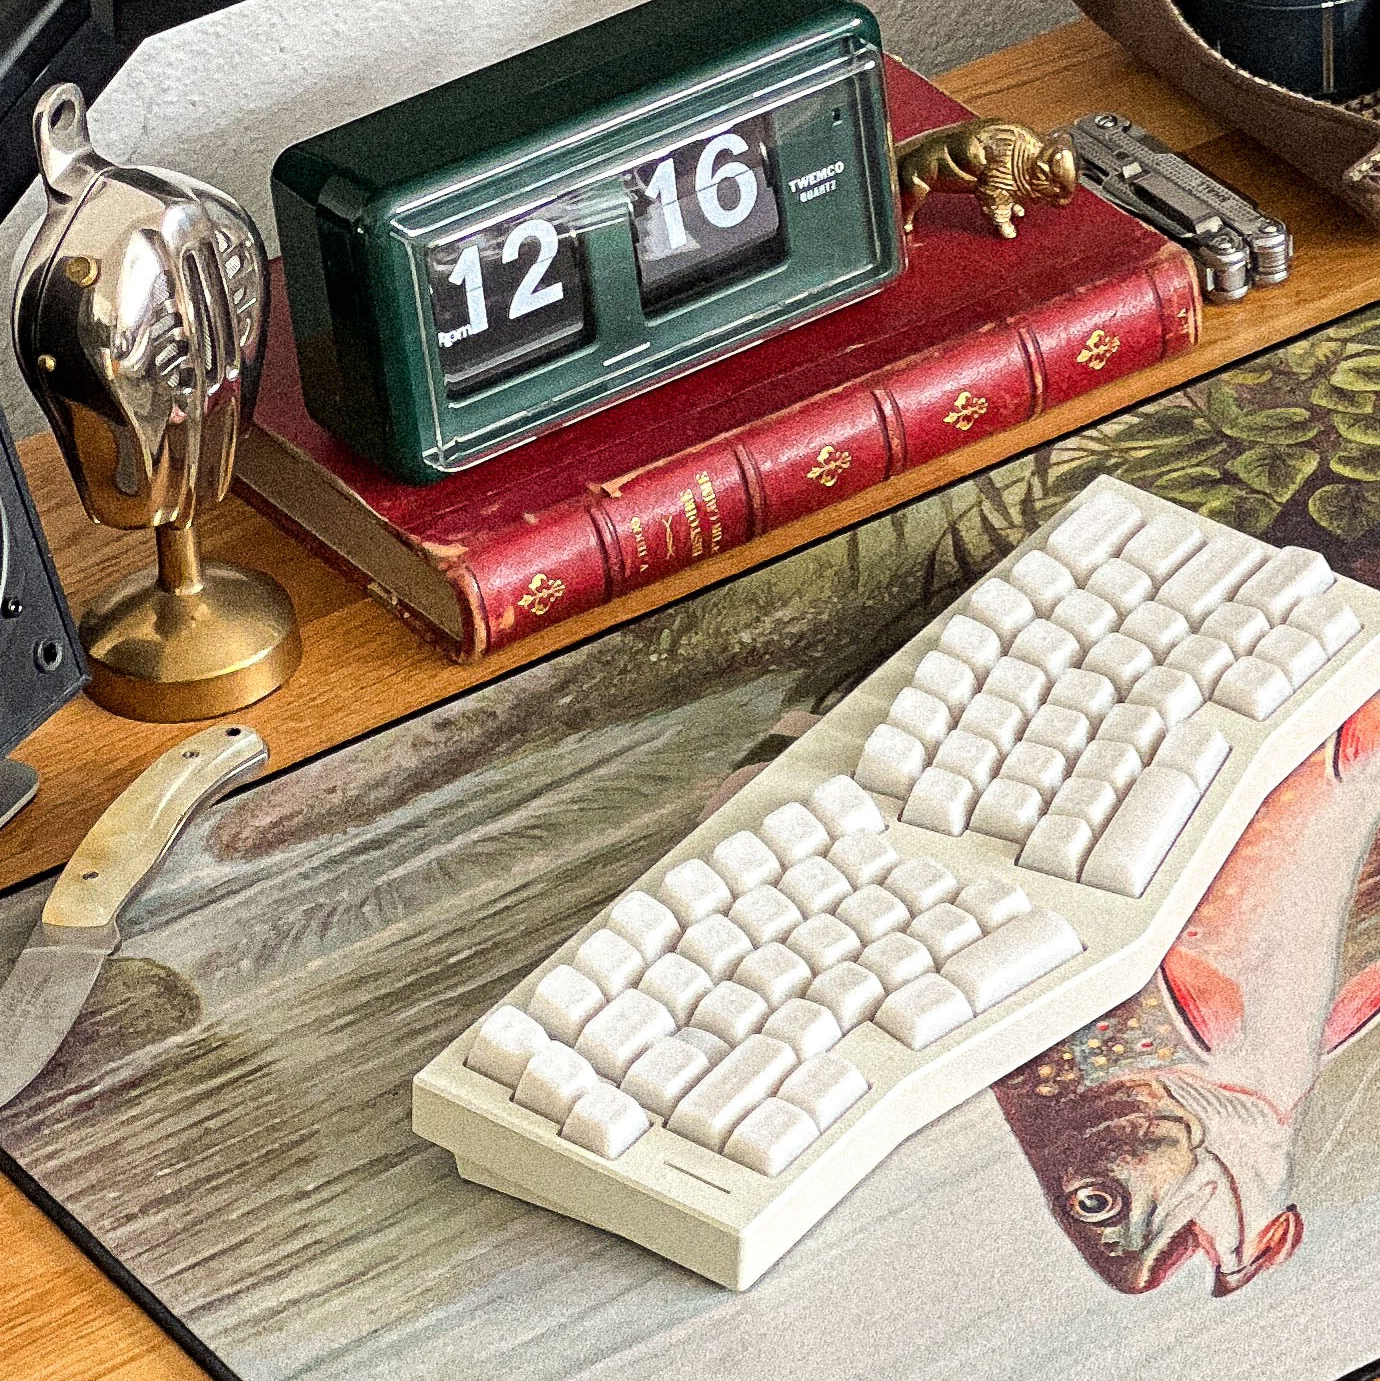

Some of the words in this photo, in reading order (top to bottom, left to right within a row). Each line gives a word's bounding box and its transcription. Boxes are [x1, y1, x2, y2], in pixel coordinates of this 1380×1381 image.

[448, 219, 563, 336] 12
[644, 133, 758, 250] 16
[788, 161, 845, 192] TWEMCO
